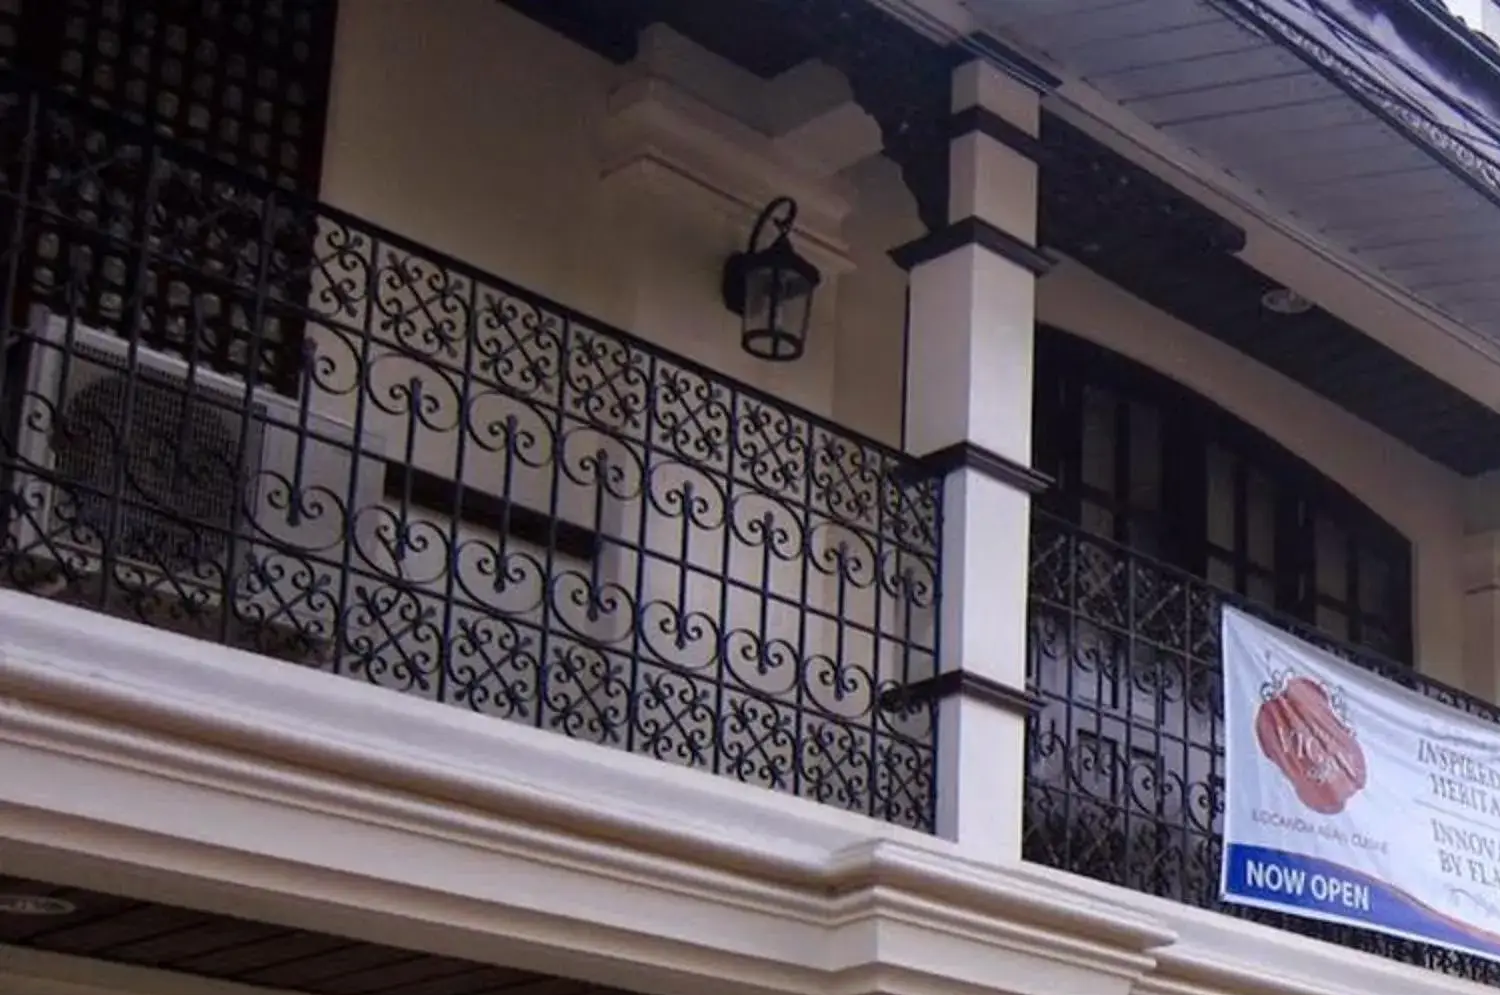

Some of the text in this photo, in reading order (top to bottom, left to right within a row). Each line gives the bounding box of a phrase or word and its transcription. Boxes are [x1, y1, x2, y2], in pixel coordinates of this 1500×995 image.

[1438, 849, 1463, 877] BY
[1246, 859, 1370, 911] NOW OPEN
